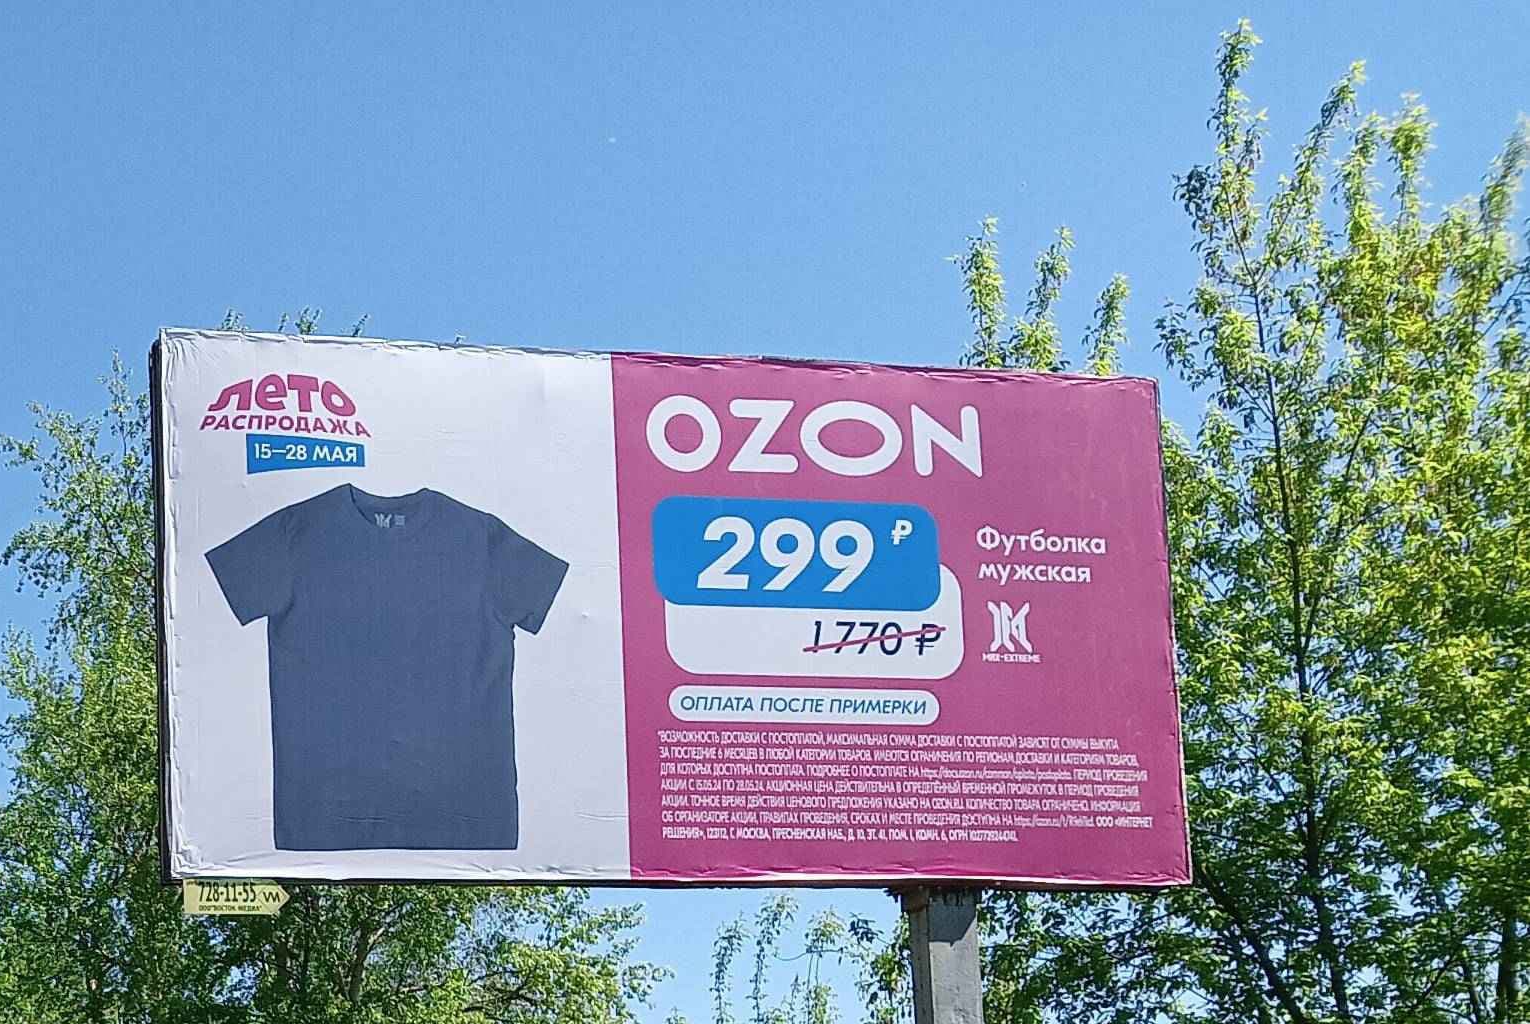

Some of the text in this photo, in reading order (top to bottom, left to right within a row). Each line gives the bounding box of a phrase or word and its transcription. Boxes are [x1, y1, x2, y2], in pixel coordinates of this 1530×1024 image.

[200, 415, 371, 438] РАСПРОДАЖА
[645, 394, 983, 478] OZON
[313, 446, 357, 463] МАЯ
[976, 525, 1107, 556] Футболка
[697, 516, 874, 593] 299
[978, 563, 1091, 586] мужская
[680, 695, 926, 715] ОПЛАТА ПОСЛЕ ПРИМЕРКИ
[721, 731, 760, 744] ДОСТАВКИ
[889, 734, 917, 746] СУММА
[659, 746, 670, 759] ЗА
[766, 746, 795, 760] ЛЮБОЙ
[963, 751, 974, 763] ПО
[660, 762, 676, 776] ДЛЯ
[677, 763, 711, 776] КОТОРЫХ
[713, 763, 753, 776] ДОСТУПНА
[661, 778, 687, 791] АКЦИИ
[723, 779, 735, 791] ПО
[814, 780, 834, 793] ЦЕНА
[662, 810, 673, 822] ОБ
[1096, 816, 1113, 828] ООО
